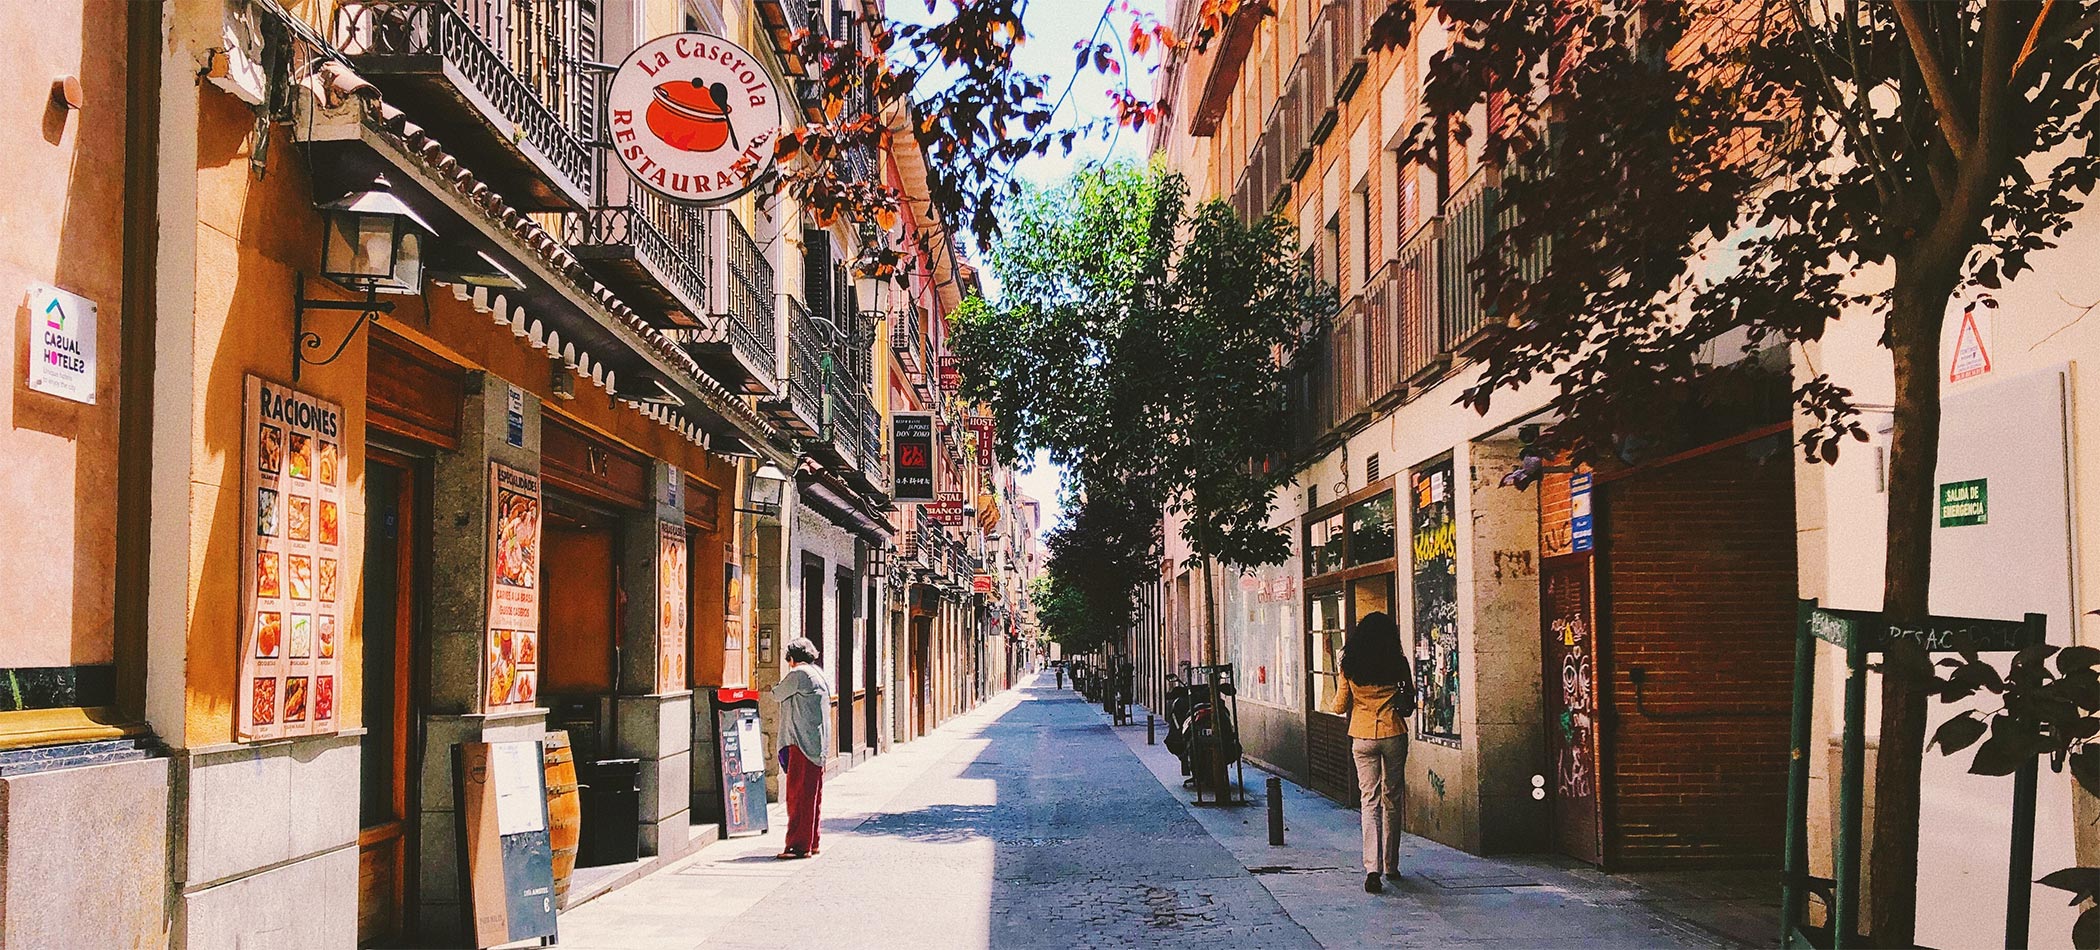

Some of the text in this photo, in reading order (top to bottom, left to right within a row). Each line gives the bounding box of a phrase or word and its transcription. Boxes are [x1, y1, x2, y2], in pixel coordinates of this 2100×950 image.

[637, 37, 767, 107] La Caserola
[44, 331, 80, 355] CASUAL
[44, 348, 85, 374] HOTELES
[260, 386, 338, 439] RACIONES
[981, 431, 989, 466] LIDO
[937, 493, 961, 502] STAL
[1946, 486, 1979, 502] SALIDA DE
[1943, 502, 1984, 518] EMERGENCIA
